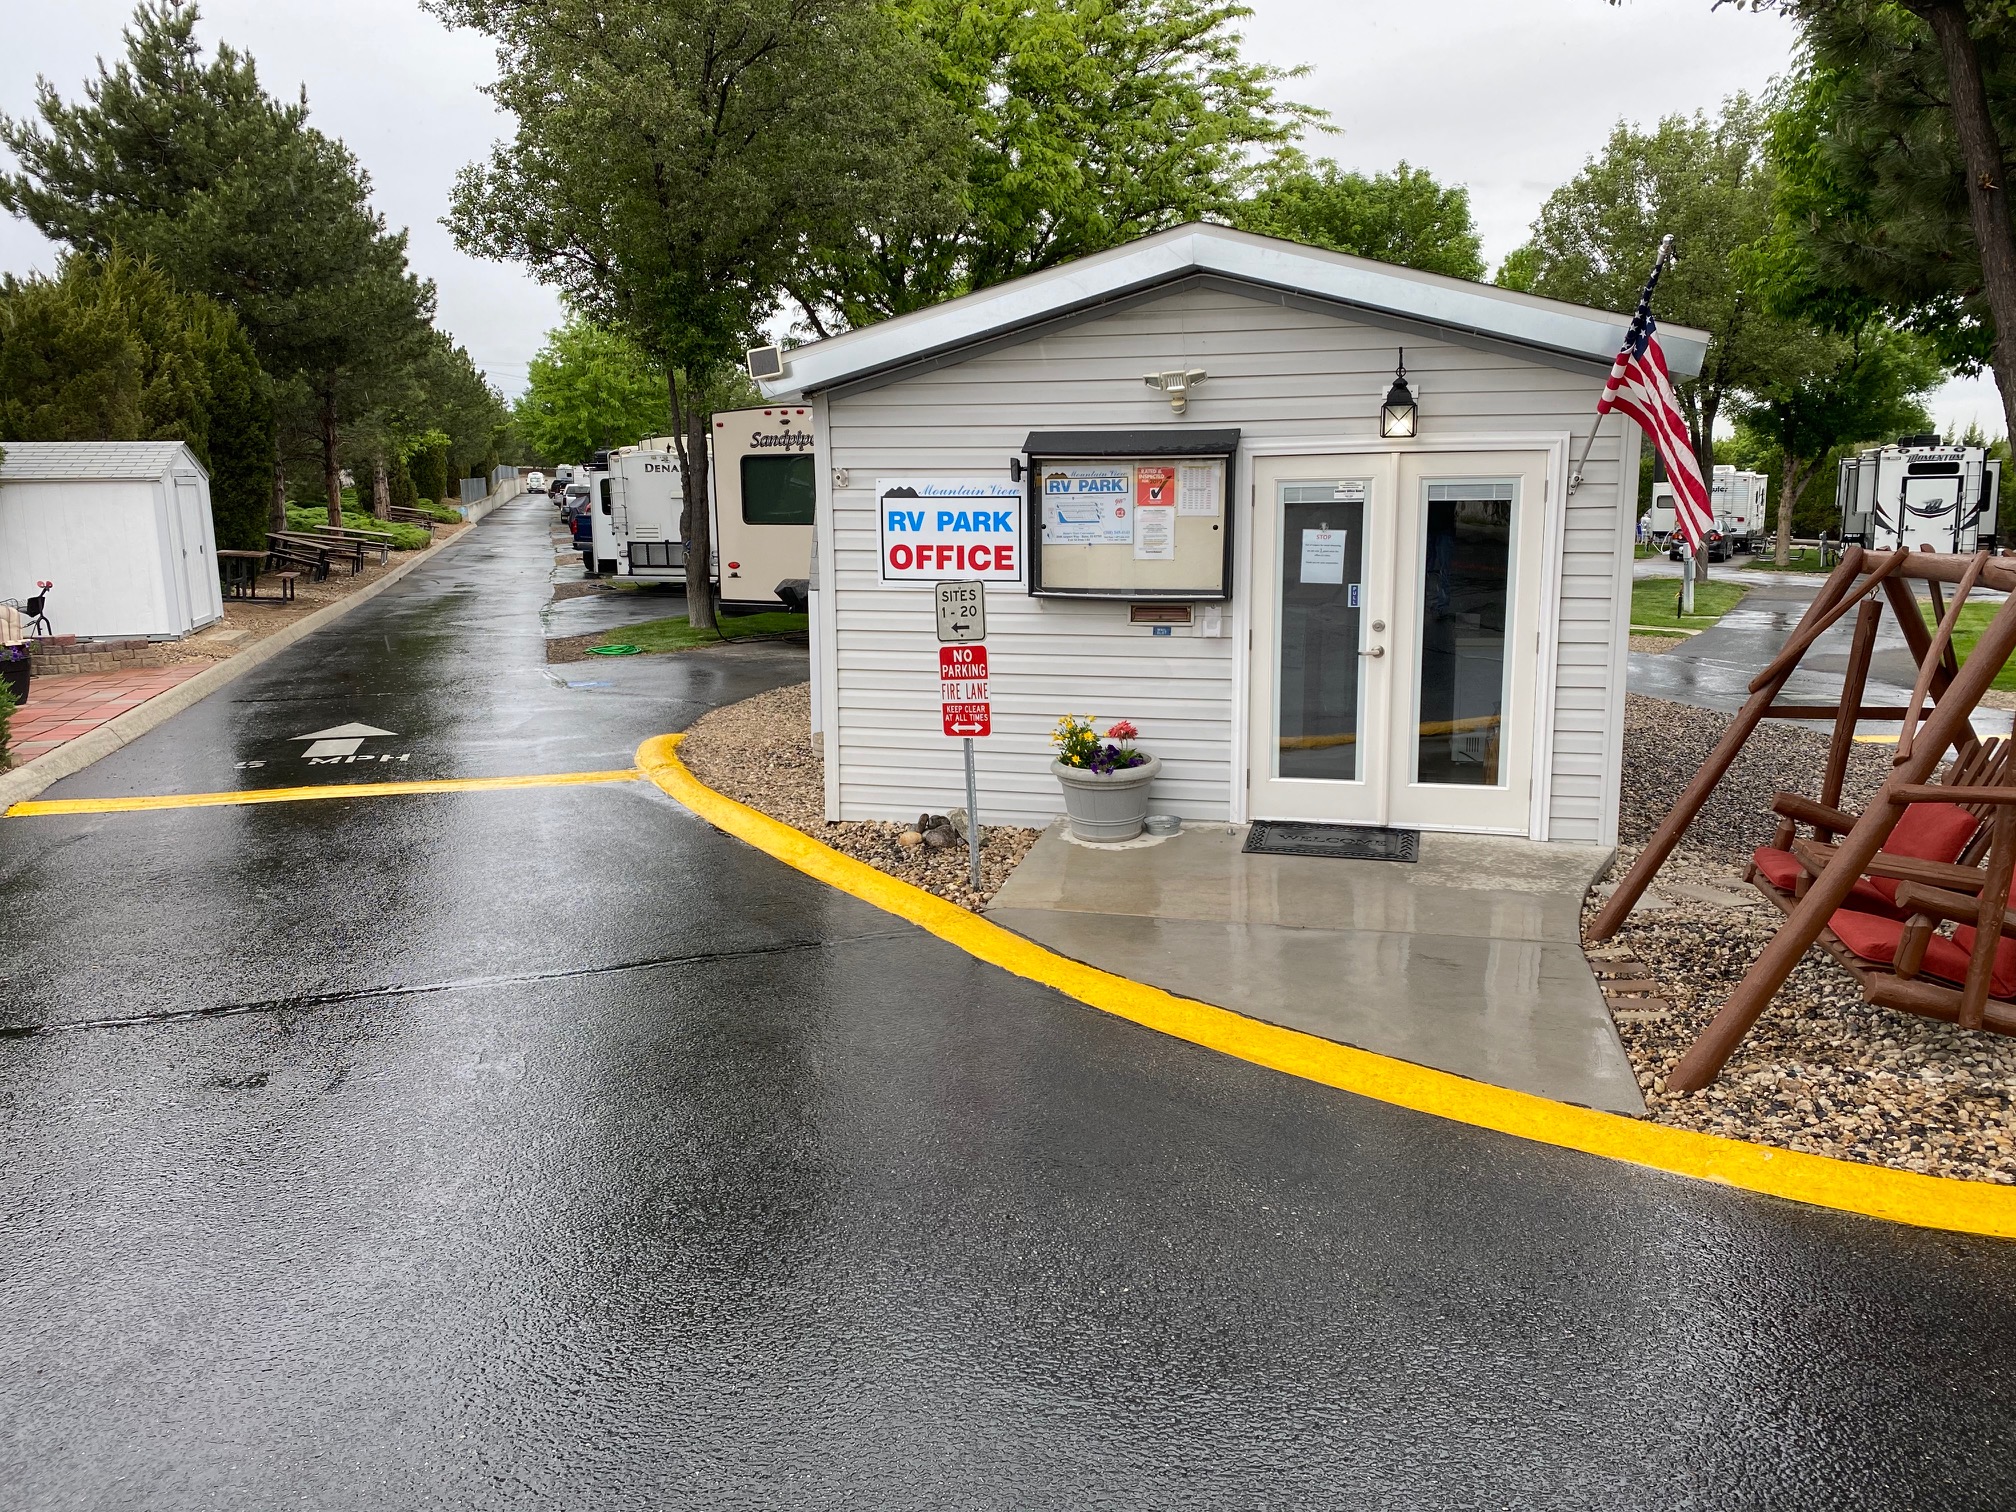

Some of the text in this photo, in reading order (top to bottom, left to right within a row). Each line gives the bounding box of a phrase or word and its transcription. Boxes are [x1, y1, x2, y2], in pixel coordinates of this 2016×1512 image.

[1906, 454, 1965, 464] MOMENTUM
[918, 484, 1021, 496] Mountain View
[1050, 479, 1123, 492] RV PARK
[888, 511, 1013, 532] RV PARK
[889, 544, 1014, 571] OFFICE
[942, 589, 976, 602] SITES
[942, 607, 946, 618] 1
[960, 606, 977, 618] 20
[953, 649, 972, 662] NO
[942, 663, 986, 678] PARKING
[942, 682, 989, 700] FIRE LANE
[946, 704, 986, 713] KEEP CLEAR
[945, 713, 988, 722] AT ALL TIMES
[307, 753, 411, 766] MPH
[1278, 835, 1387, 847] WELCOME
